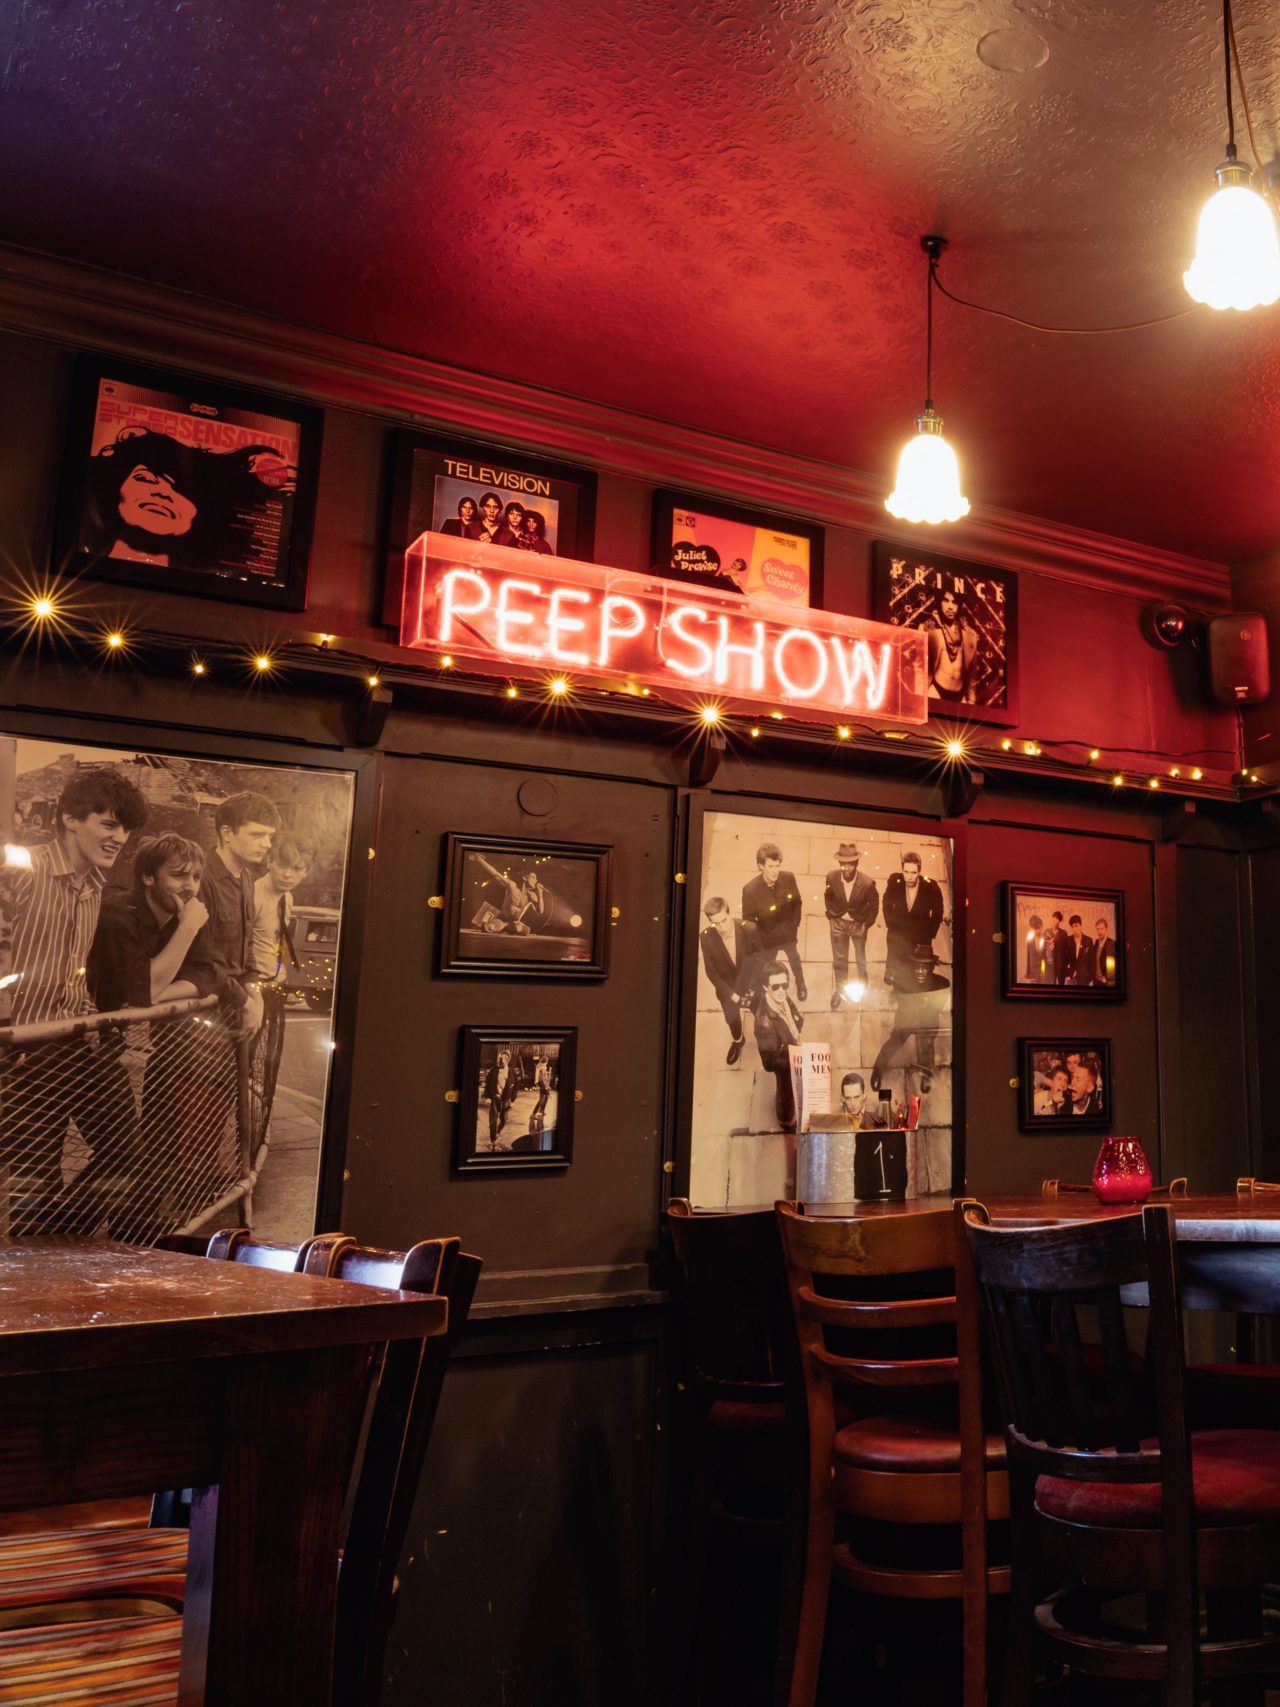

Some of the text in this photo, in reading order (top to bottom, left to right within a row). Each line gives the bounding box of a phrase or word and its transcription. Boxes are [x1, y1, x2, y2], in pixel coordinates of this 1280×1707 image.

[99, 400, 179, 426] SUPER
[444, 459, 550, 495] TELEVISION
[674, 549, 707, 561] Juliet
[681, 560, 718, 572] Prowse
[763, 562, 795, 579] Sweet
[891, 561, 1005, 602] PRINCE
[766, 574, 805, 594] Charity
[440, 569, 892, 710] PEEP SHOW
[873, 1141, 892, 1193] 1
